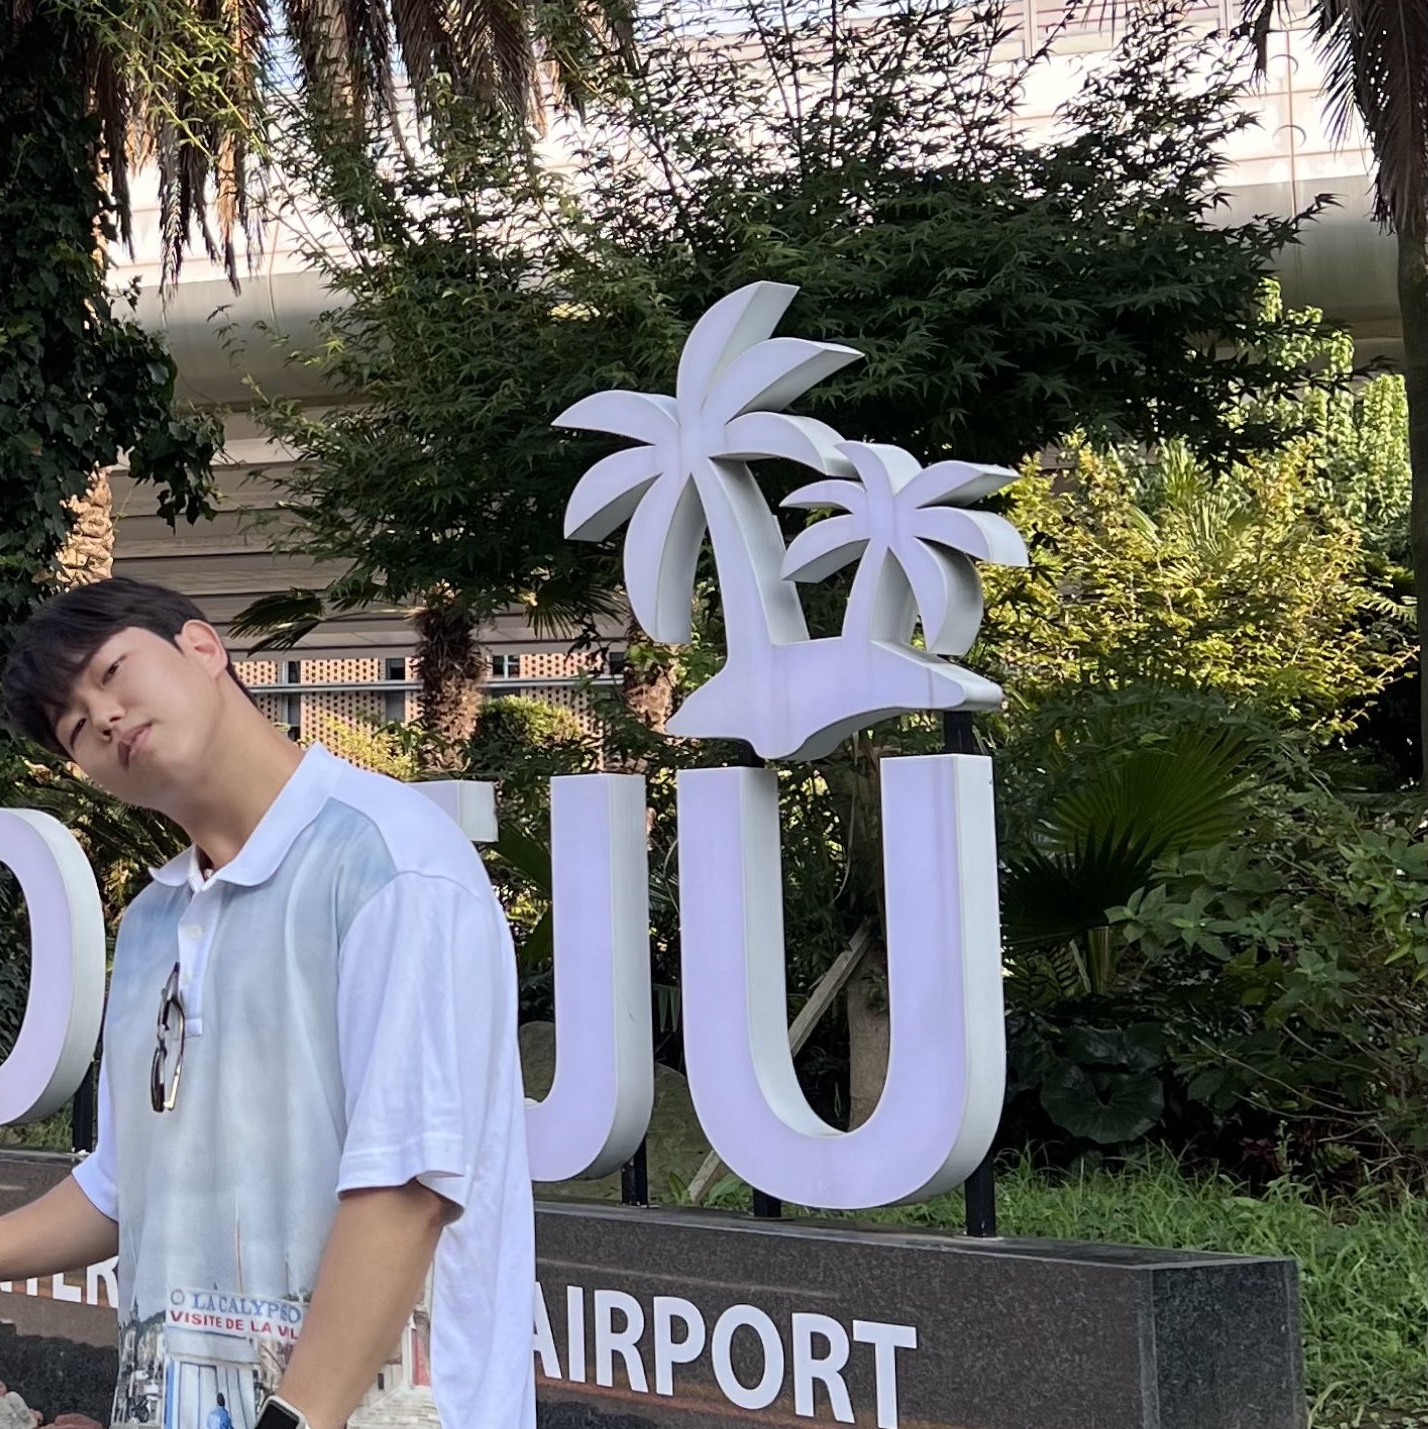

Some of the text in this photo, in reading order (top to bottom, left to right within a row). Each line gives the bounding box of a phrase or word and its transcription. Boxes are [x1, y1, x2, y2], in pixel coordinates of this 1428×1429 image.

[406, 753, 1006, 1209] JU
[170, 1311, 300, 1340] VISITE DE LA VIL
